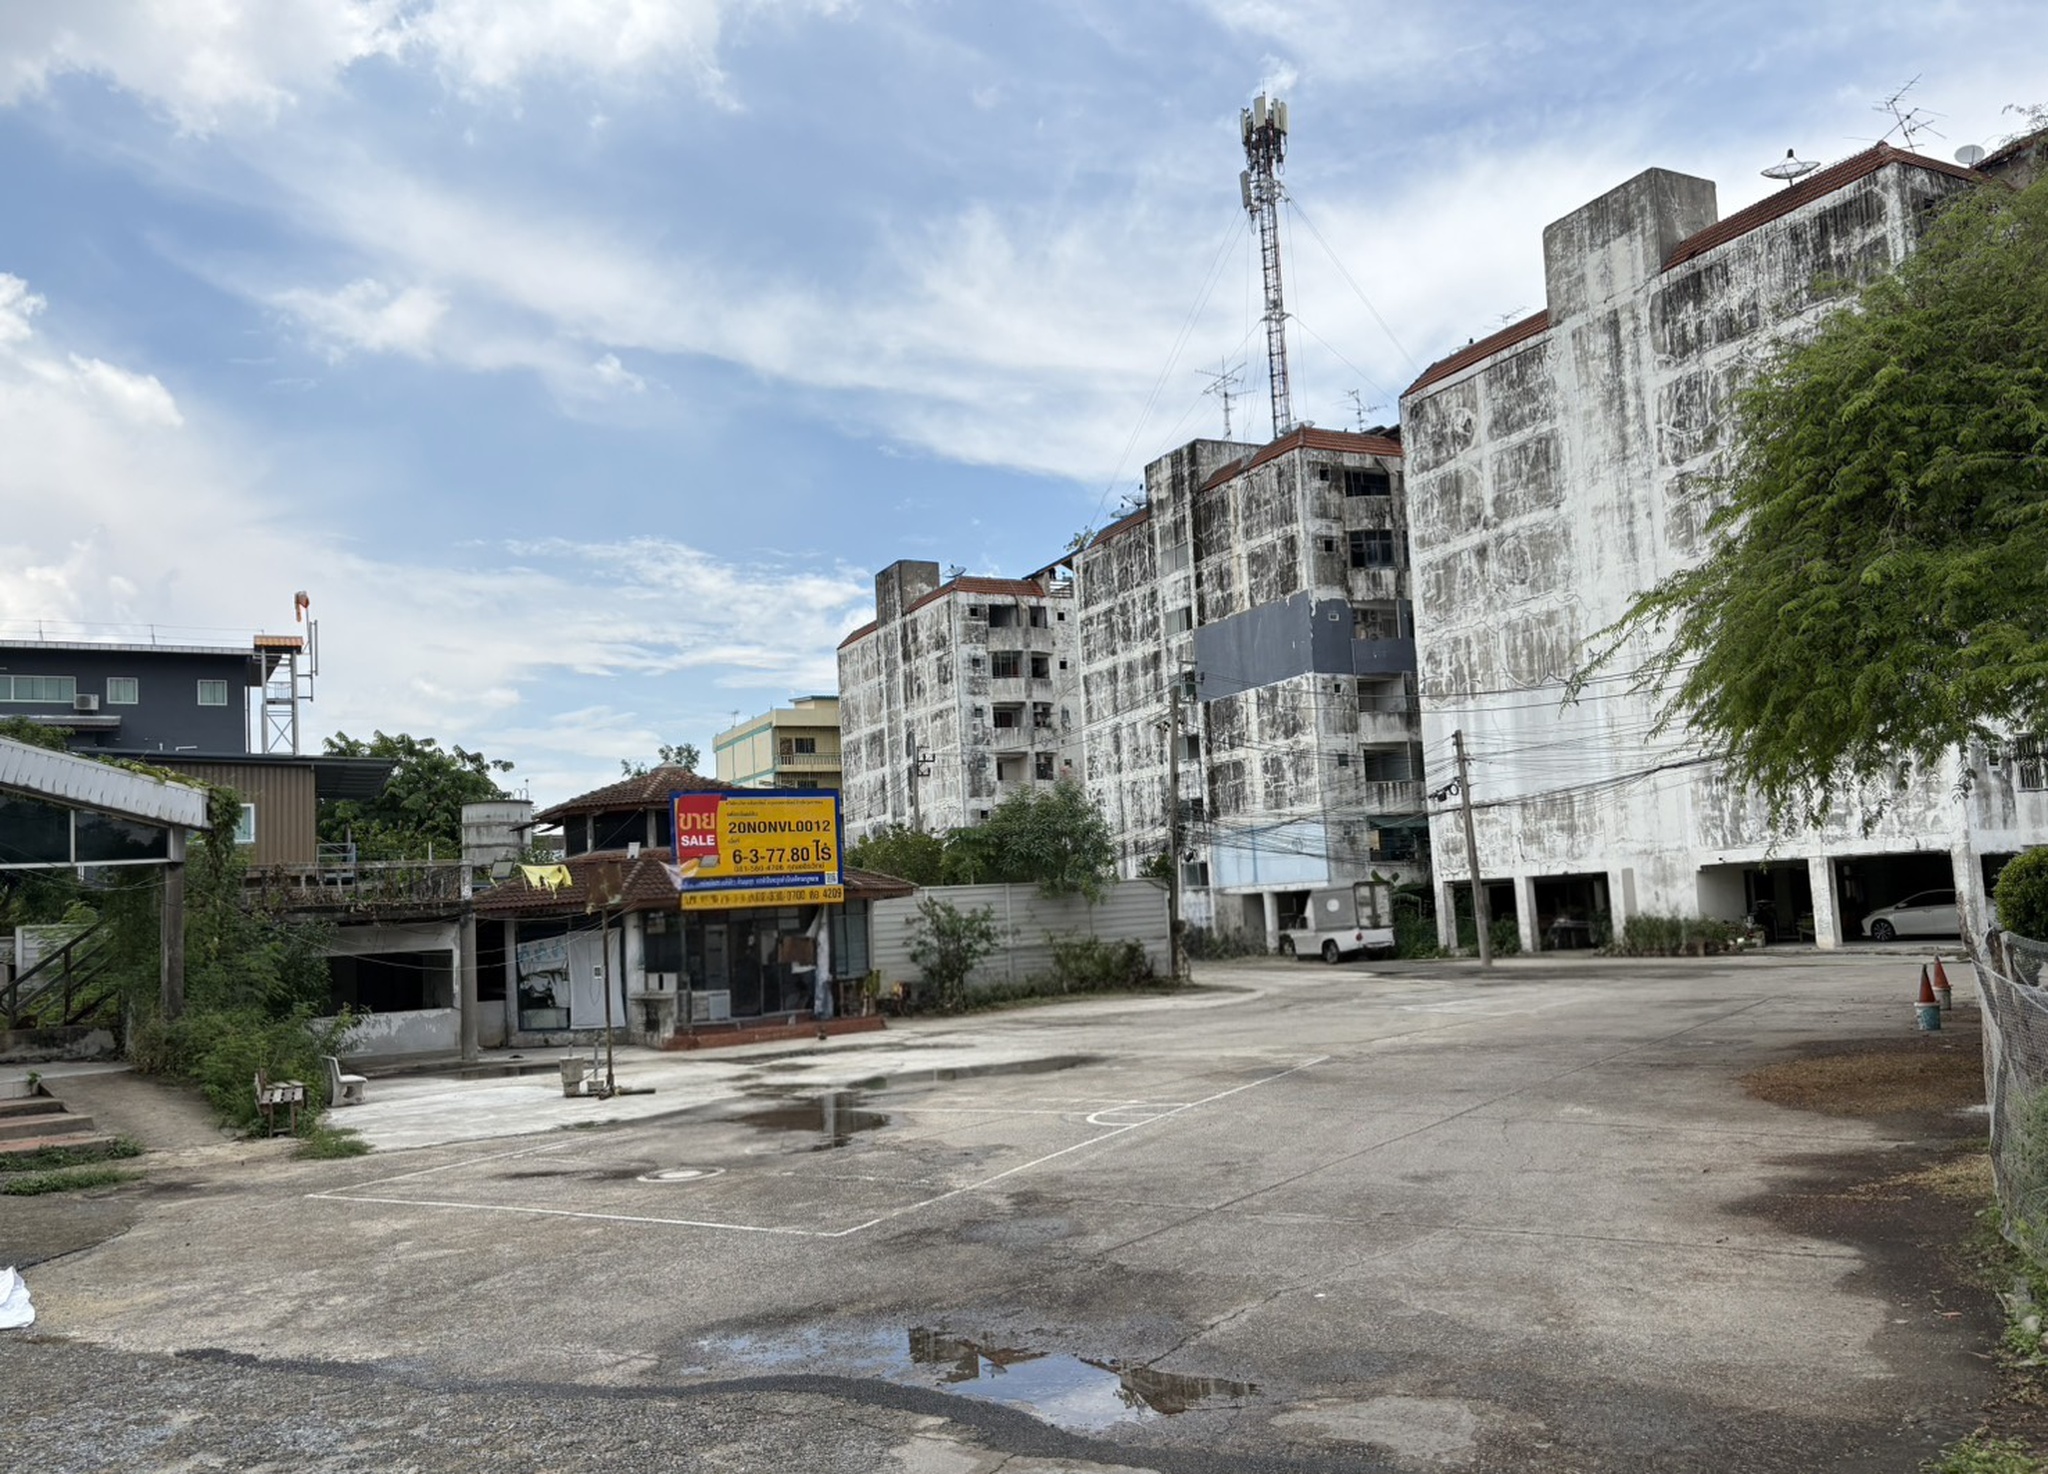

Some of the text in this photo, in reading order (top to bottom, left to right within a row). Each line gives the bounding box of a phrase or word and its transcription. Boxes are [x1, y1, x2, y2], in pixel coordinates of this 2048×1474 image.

[679, 812, 715, 830] ขาย
[728, 820, 831, 834] 20NONVL0012
[681, 834, 716, 847] SALE
[732, 839, 832, 864] 6-3-77.80 ไร่
[823, 888, 842, 899] 4209
